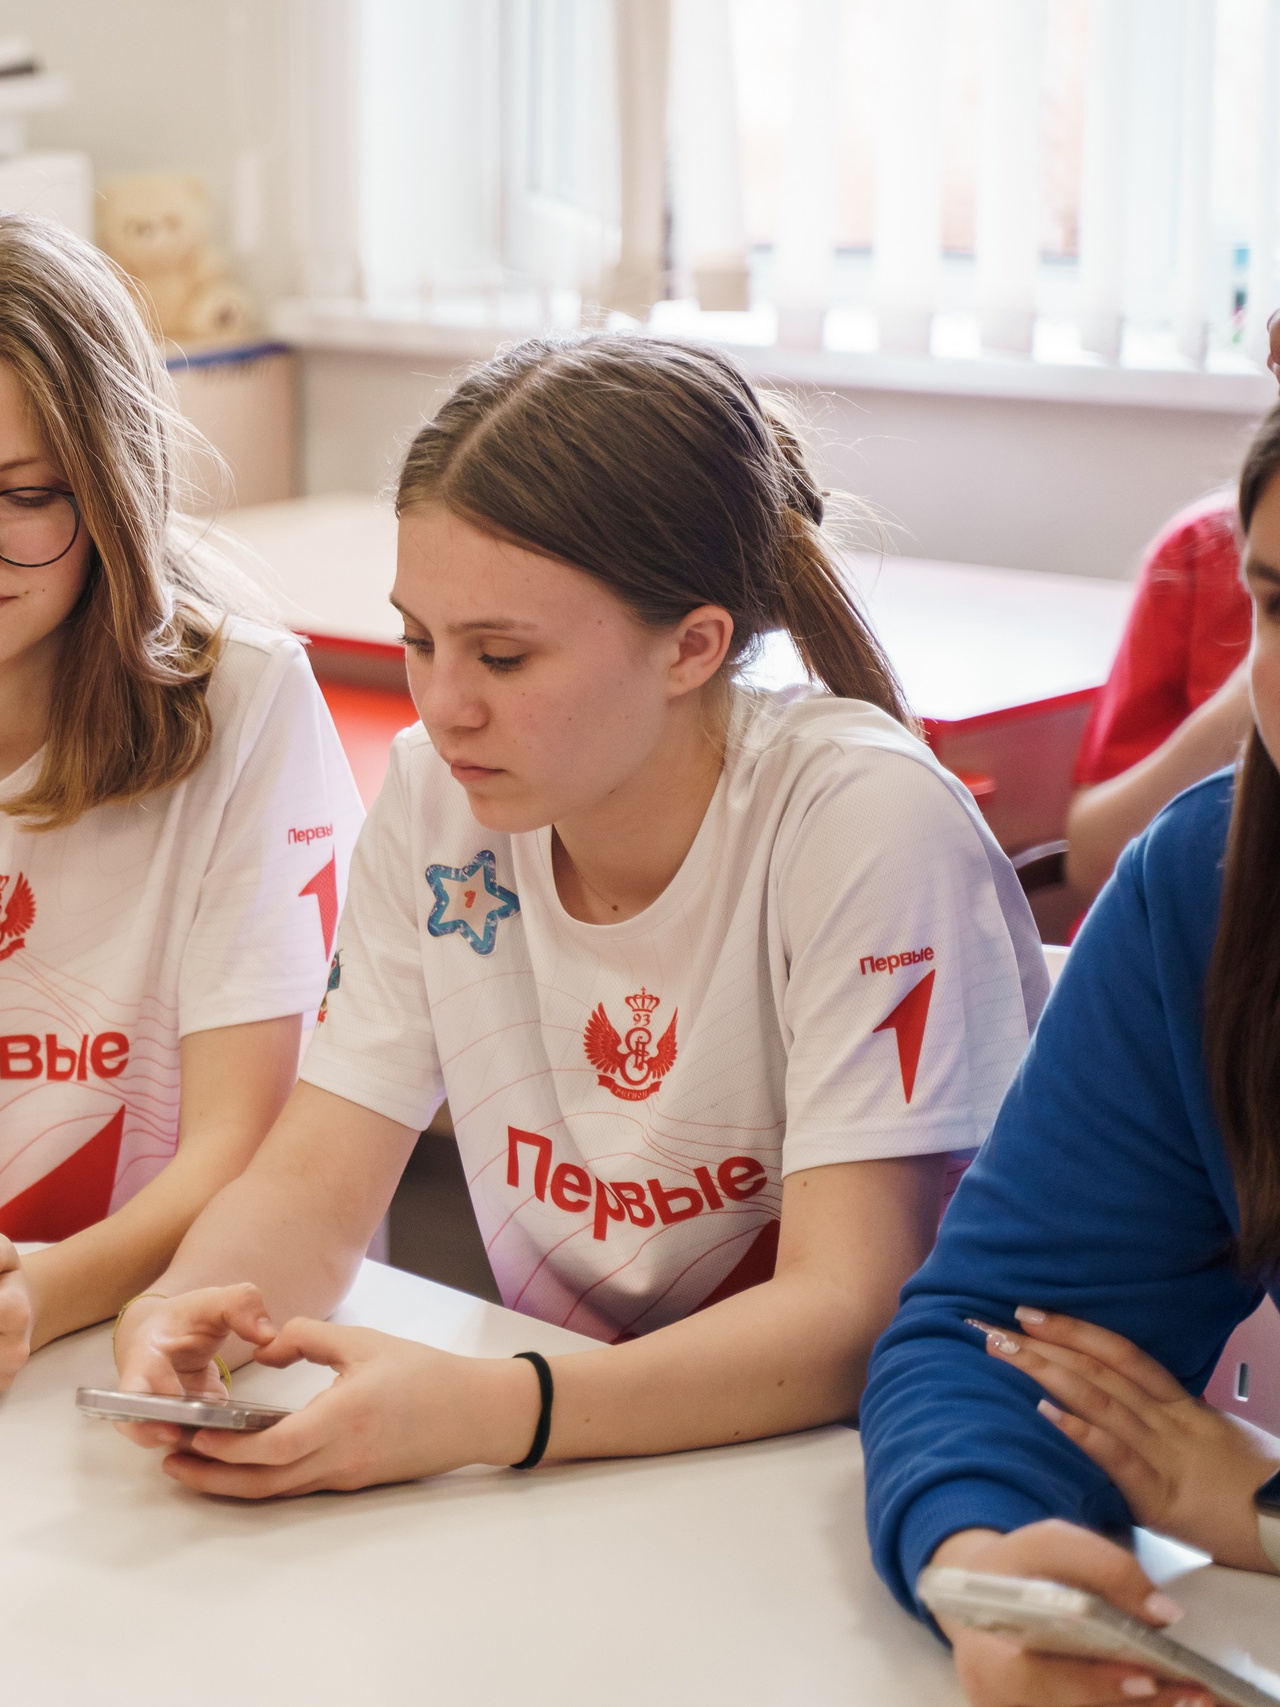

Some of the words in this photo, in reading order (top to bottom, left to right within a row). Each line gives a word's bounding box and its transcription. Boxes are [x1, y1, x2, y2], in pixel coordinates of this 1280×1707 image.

[287, 823, 333, 847] Первы
[859, 946, 935, 976] Первые
[632, 1013, 651, 1027] 93
[506, 1125, 768, 1242] Первые
